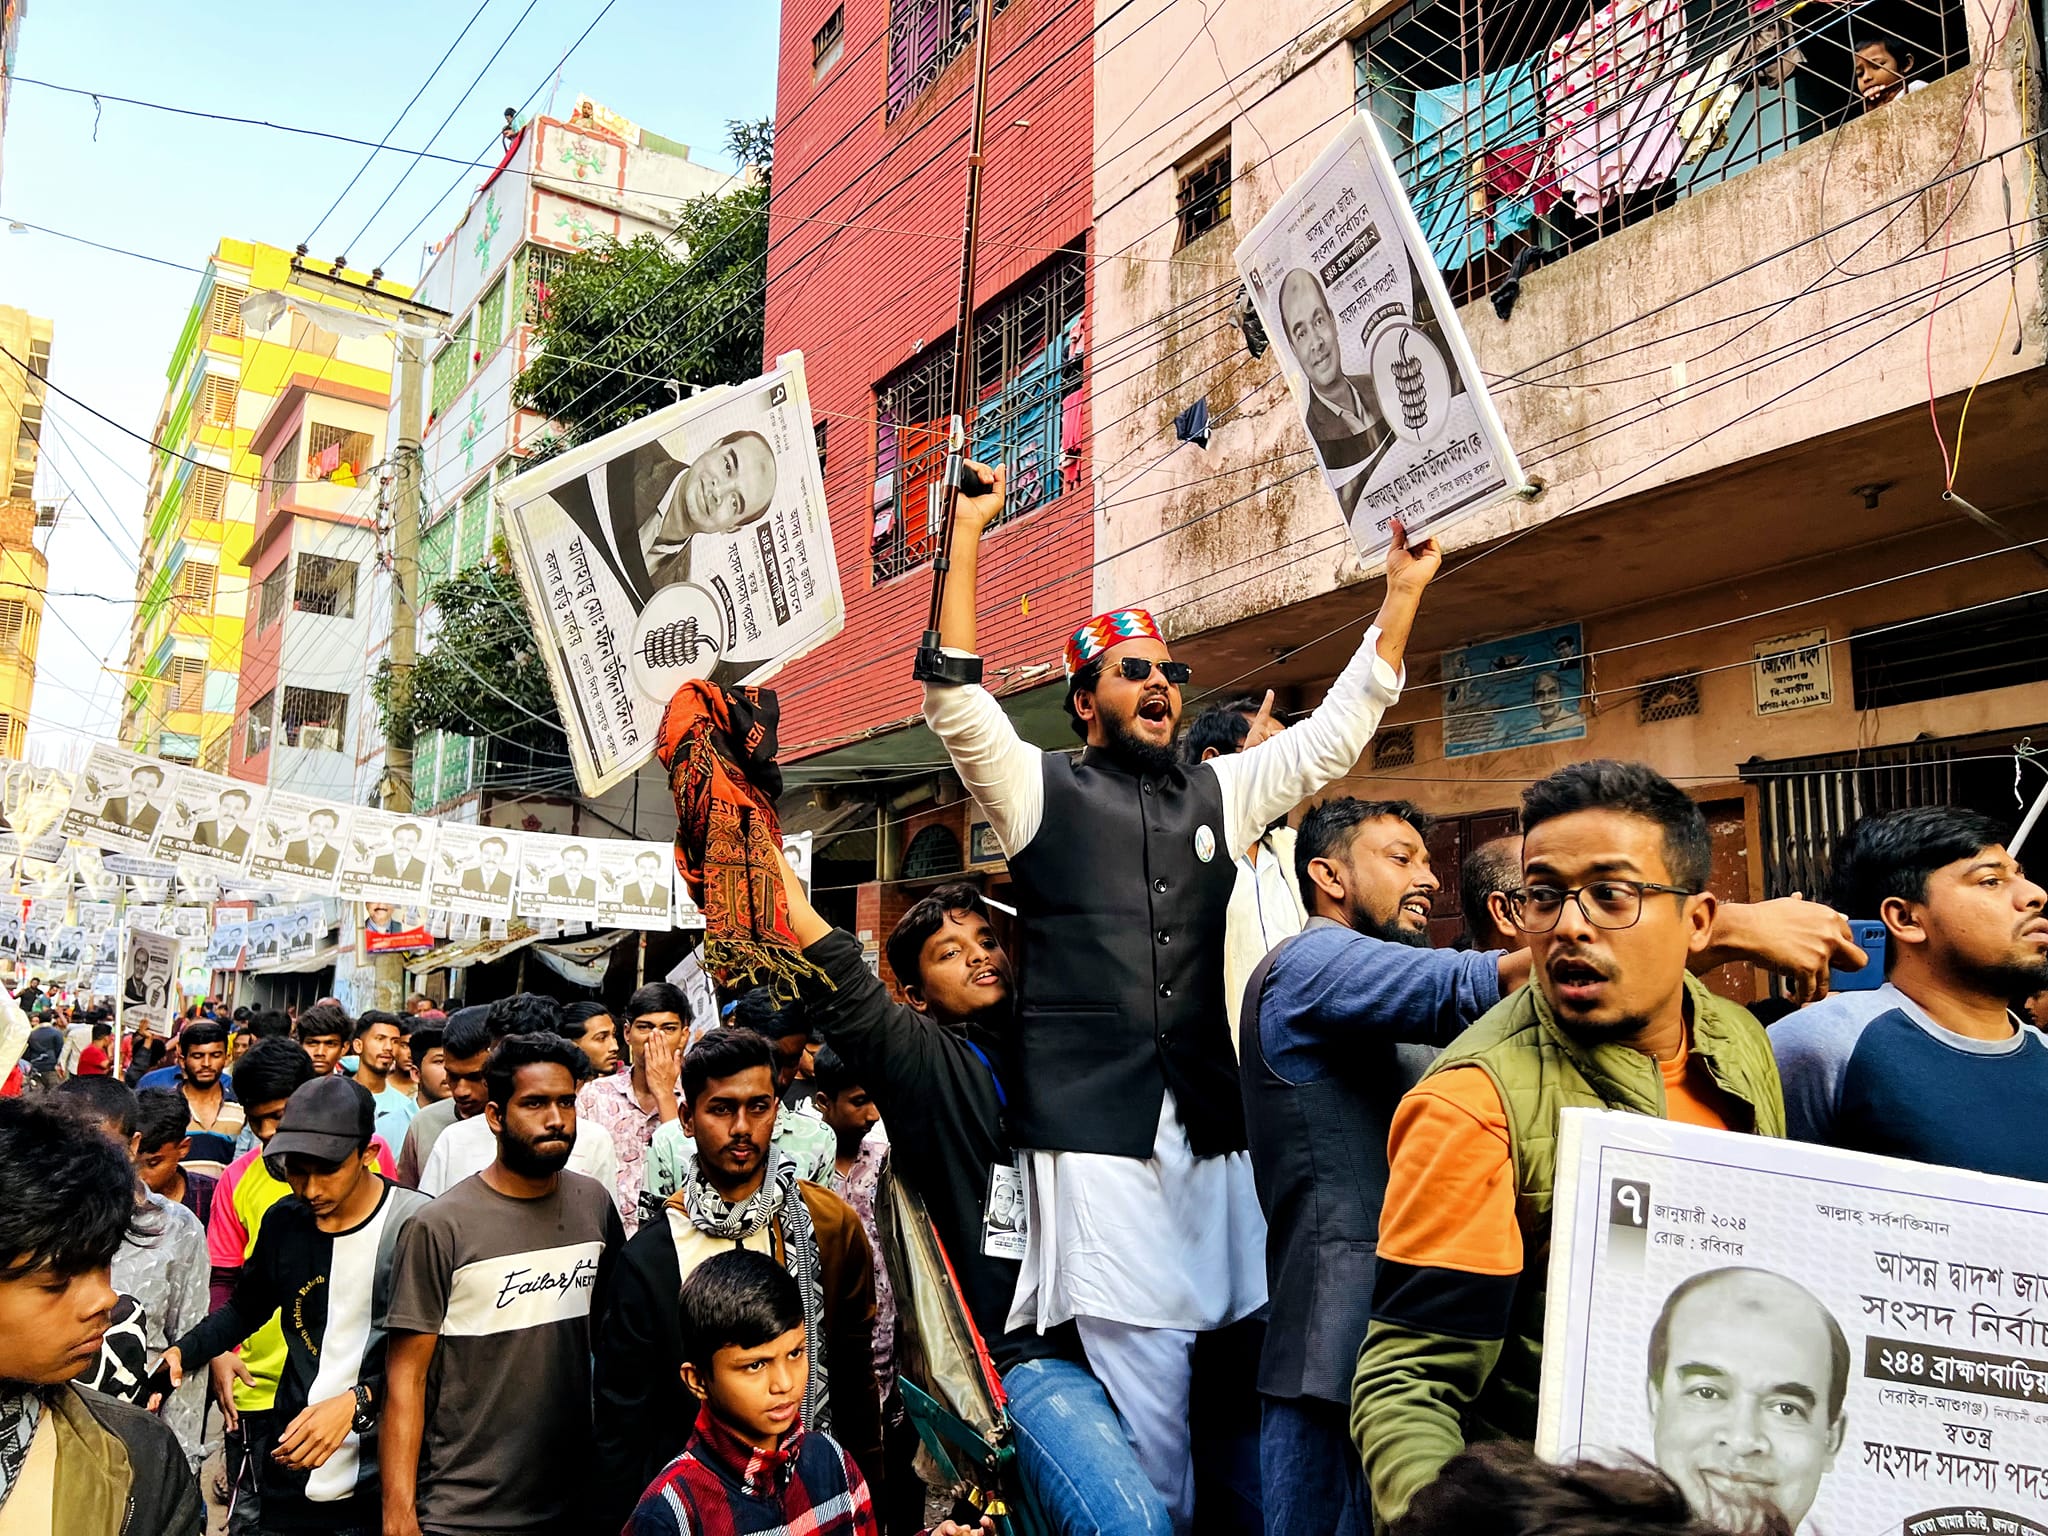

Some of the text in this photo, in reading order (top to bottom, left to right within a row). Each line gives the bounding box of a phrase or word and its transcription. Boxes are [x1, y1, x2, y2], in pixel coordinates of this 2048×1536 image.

[1305, 220, 1325, 242] আসন্ন
[1335, 187, 1358, 212] জাতীয়
[1310, 236, 1336, 264] সংসদ
[1335, 203, 1370, 242] নির্বাচনে
[1324, 265, 1337, 280] ২৪৪
[1339, 300, 1358, 324] সংসদ
[772, 387, 784, 403] ৭
[1467, 432, 1483, 454] কে
[759, 529, 770, 550] ২৪৪
[789, 507, 815, 599] আসন্ন দ্বাদশ জাতীয়
[542, 549, 562, 584] কলার
[727, 541, 742, 574] সংসদ
[775, 510, 802, 614] সংসদ নির্বাচনে
[554, 584, 571, 610] ছড়ি
[734, 573, 749, 604] সদস্য
[560, 610, 584, 647] মার্কায়
[565, 536, 596, 599] আলহাজ্ব
[582, 597, 604, 625] মোঃ
[621, 728, 639, 747] কে
[579, 652, 593, 675] ভোট
[586, 676, 600, 698] দিয়ে
[1617, 1185, 1643, 1225] ৭
[1654, 1204, 1747, 1231] জানুয়ারী ২০২৪
[1868, 1211, 1951, 1236] সর্বশক্তিমান
[1654, 1231, 1685, 1247] রোজ
[1699, 1236, 1745, 1257] রবিবার
[1874, 1251, 1940, 1291] আসন্ন
[1948, 1261, 2004, 1297] দ্বাদশ
[1860, 1295, 1957, 1336] সংসদ
[1880, 1348, 1924, 1376] ২৪৪
[1942, 1422, 1993, 1451] স্বতন্ত্র
[1863, 1441, 1932, 1479] সংসদ
[1936, 1452, 1999, 1493] সদস্য
